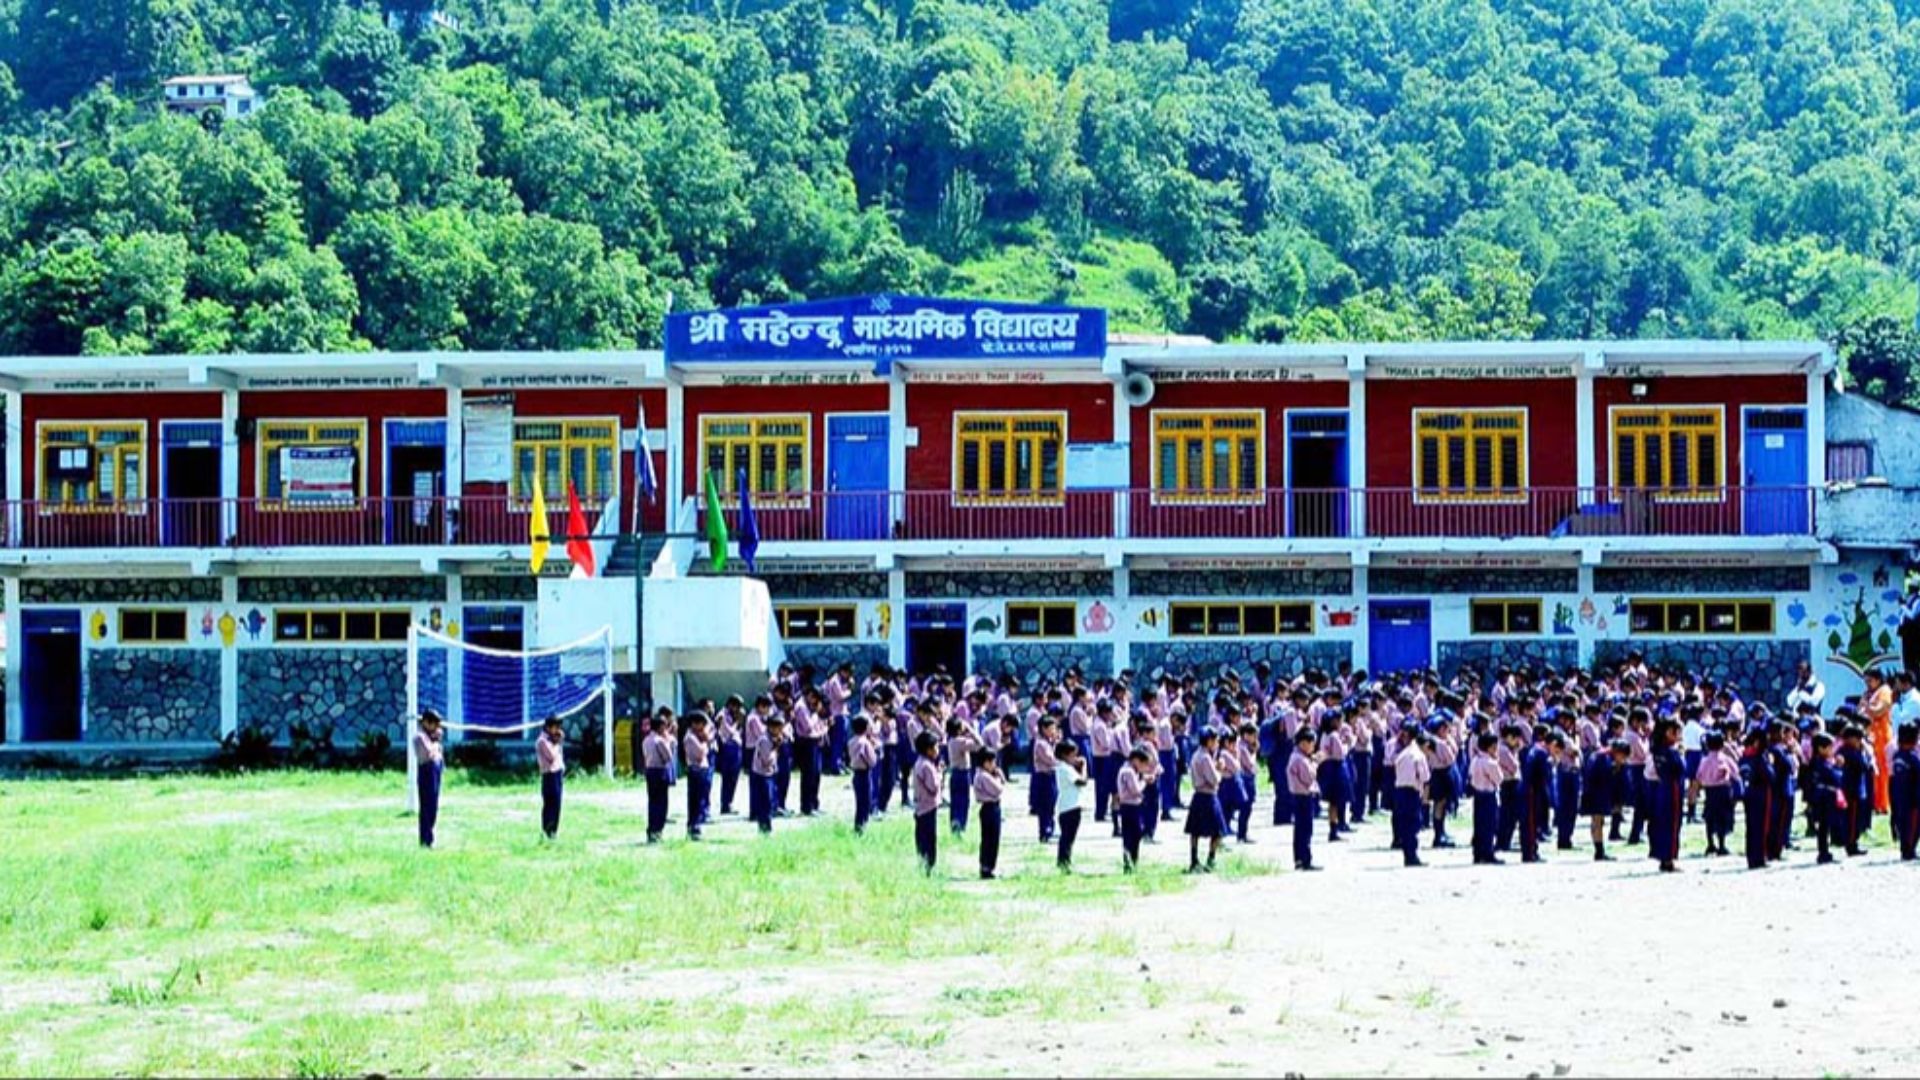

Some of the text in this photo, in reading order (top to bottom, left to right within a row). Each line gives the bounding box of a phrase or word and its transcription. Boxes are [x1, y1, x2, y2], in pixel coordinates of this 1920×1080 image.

[689, 312, 729, 345] श्री
[852, 307, 967, 340] माध्यमिक
[971, 307, 1080, 339] विद्यालय
